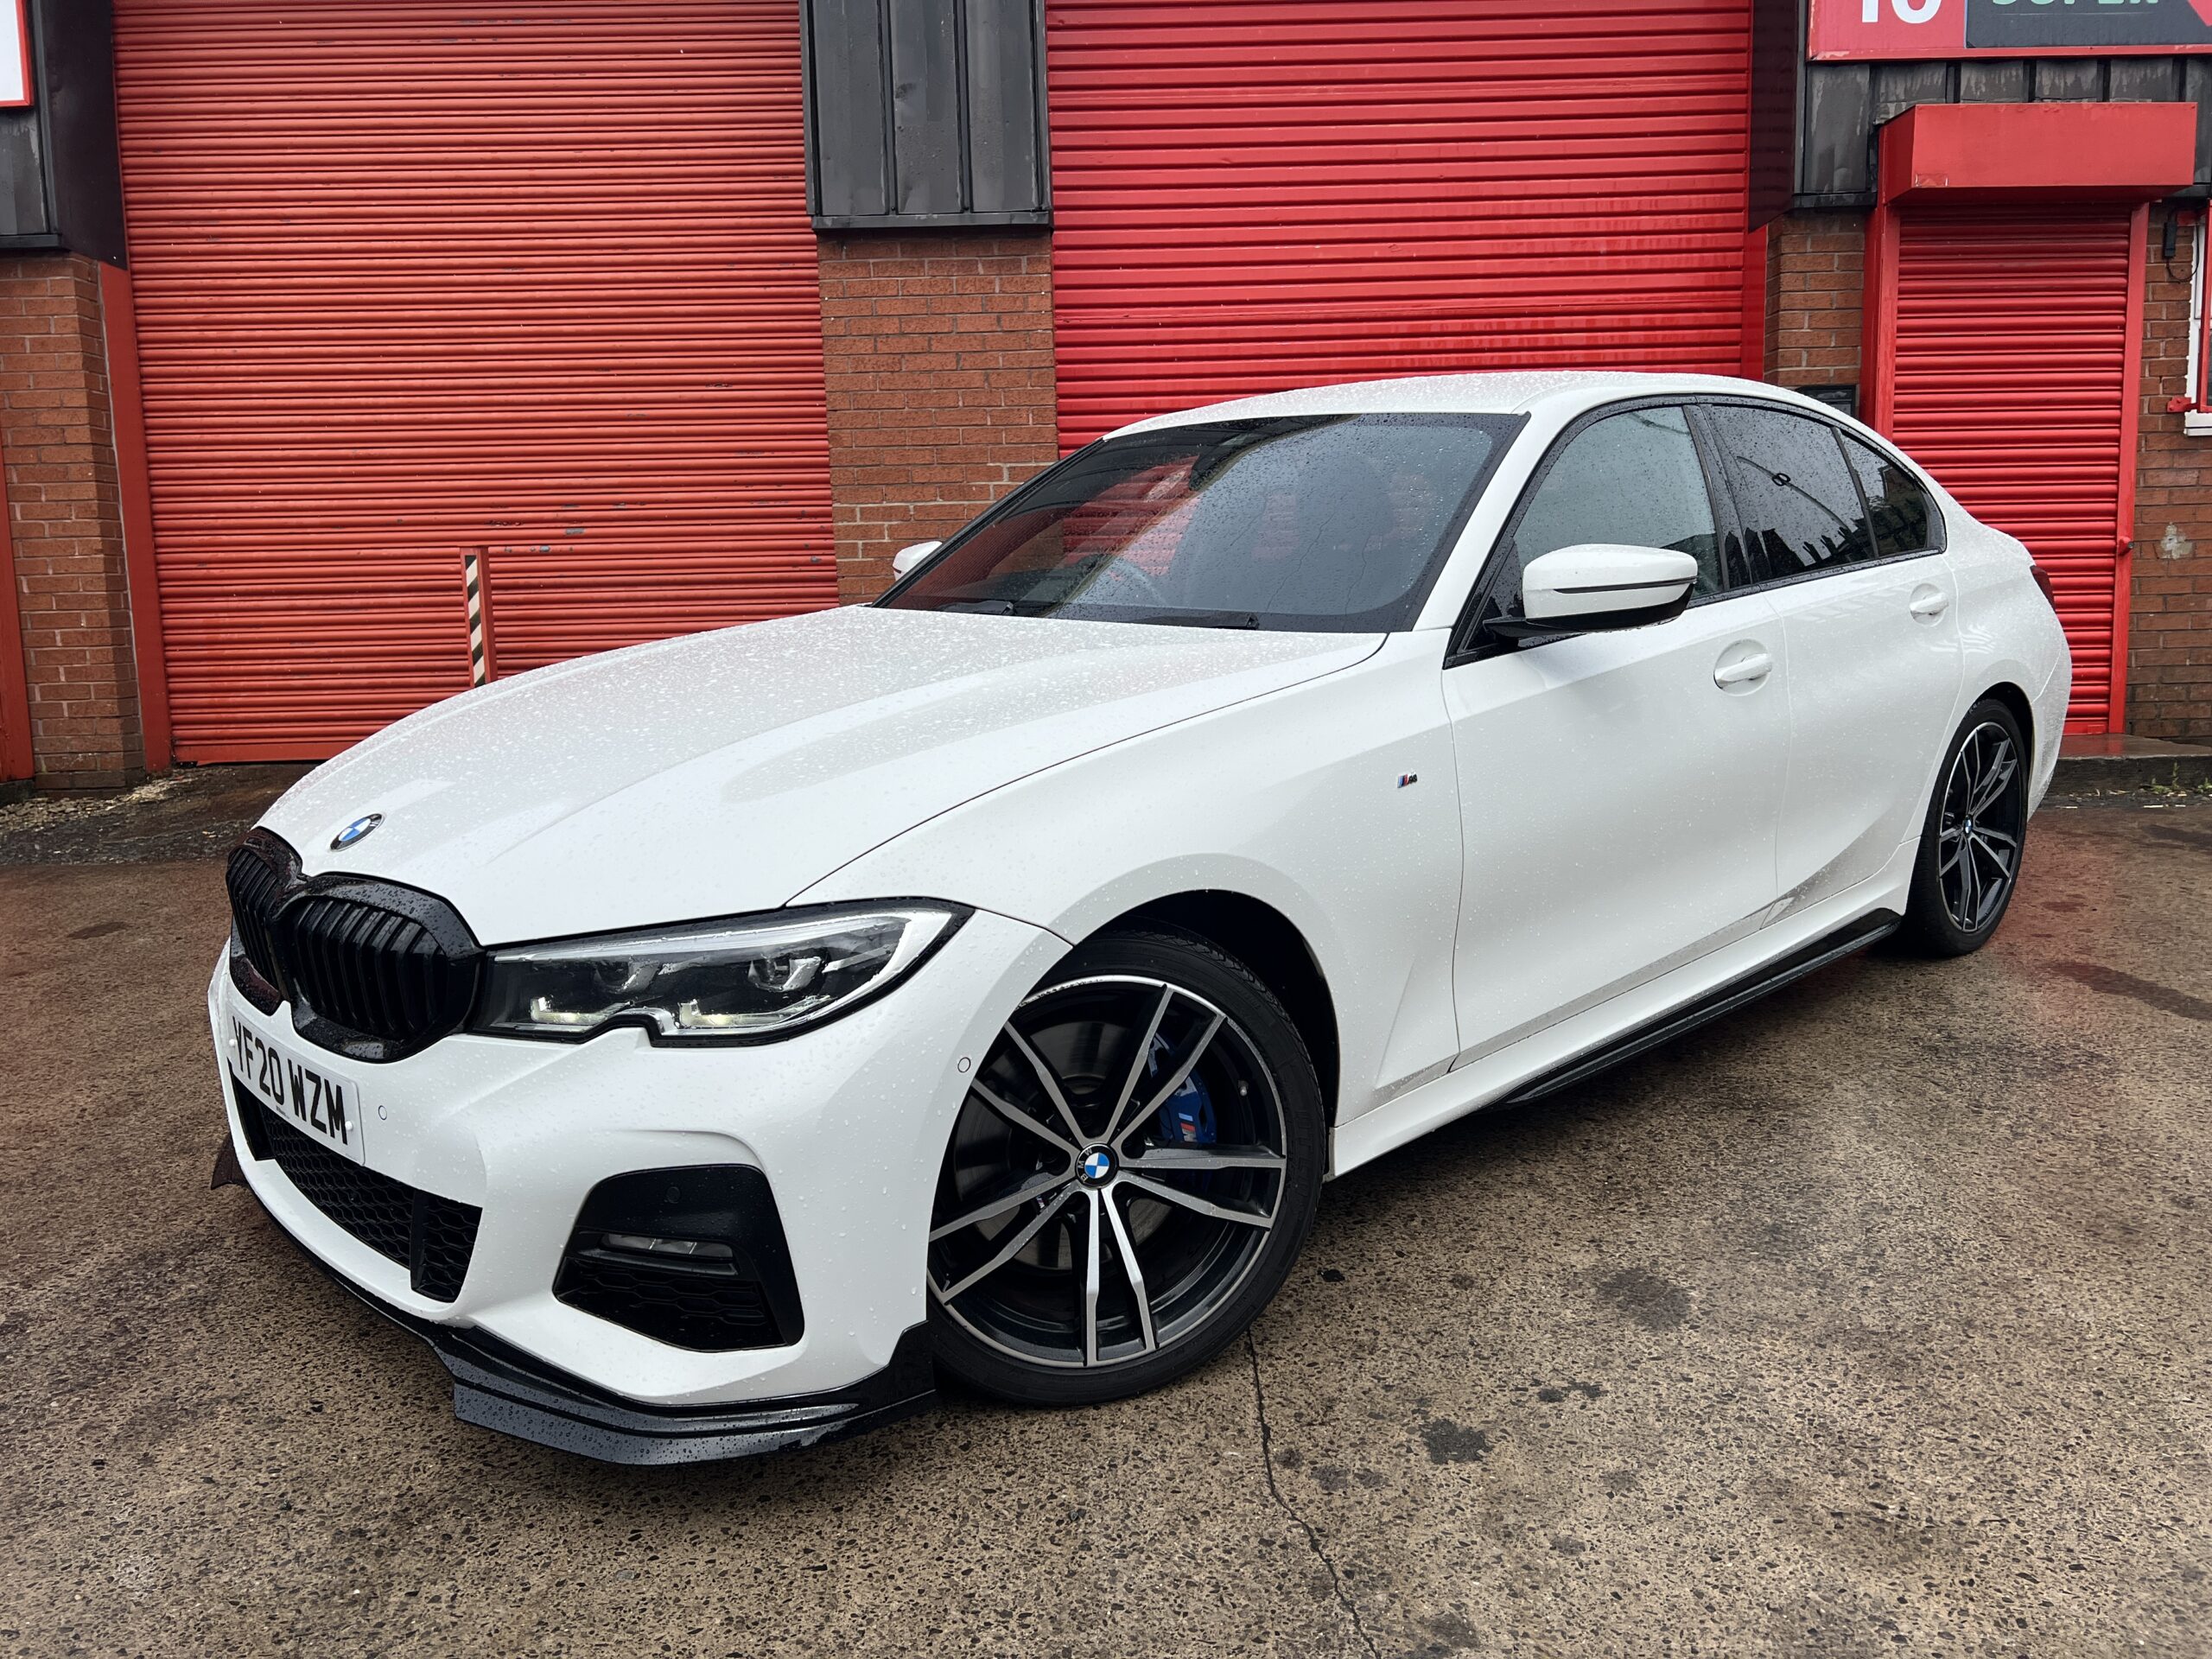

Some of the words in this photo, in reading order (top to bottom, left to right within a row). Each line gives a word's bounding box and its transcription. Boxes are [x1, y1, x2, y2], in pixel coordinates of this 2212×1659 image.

[232, 1015, 284, 1106] YF20
[287, 1058, 348, 1146] WZM
[1077, 1147, 1093, 1184] BMW
